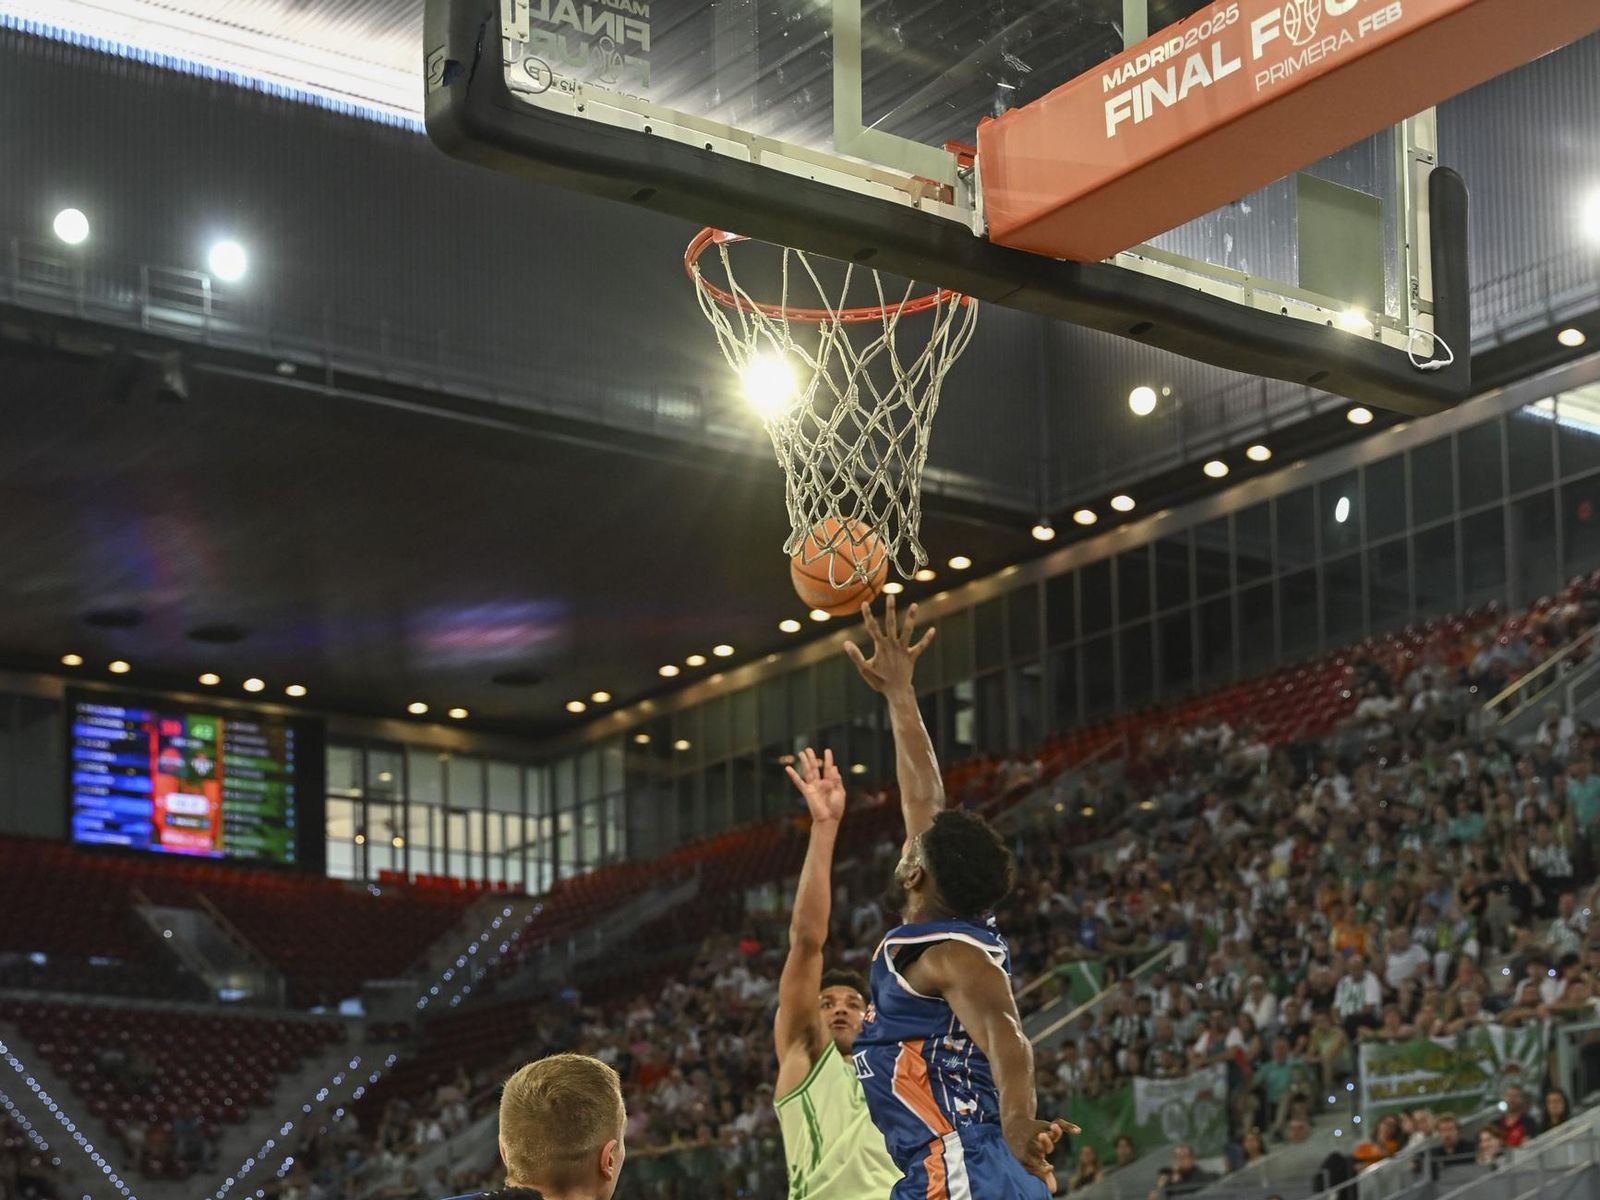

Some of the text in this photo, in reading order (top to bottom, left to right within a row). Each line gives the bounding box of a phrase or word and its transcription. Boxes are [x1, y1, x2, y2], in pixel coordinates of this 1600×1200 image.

[1102, 2, 1240, 94] MADRID2025
[1104, 40, 1242, 139] FINAL
[1255, 1, 1403, 92] PRIMERA FEB
